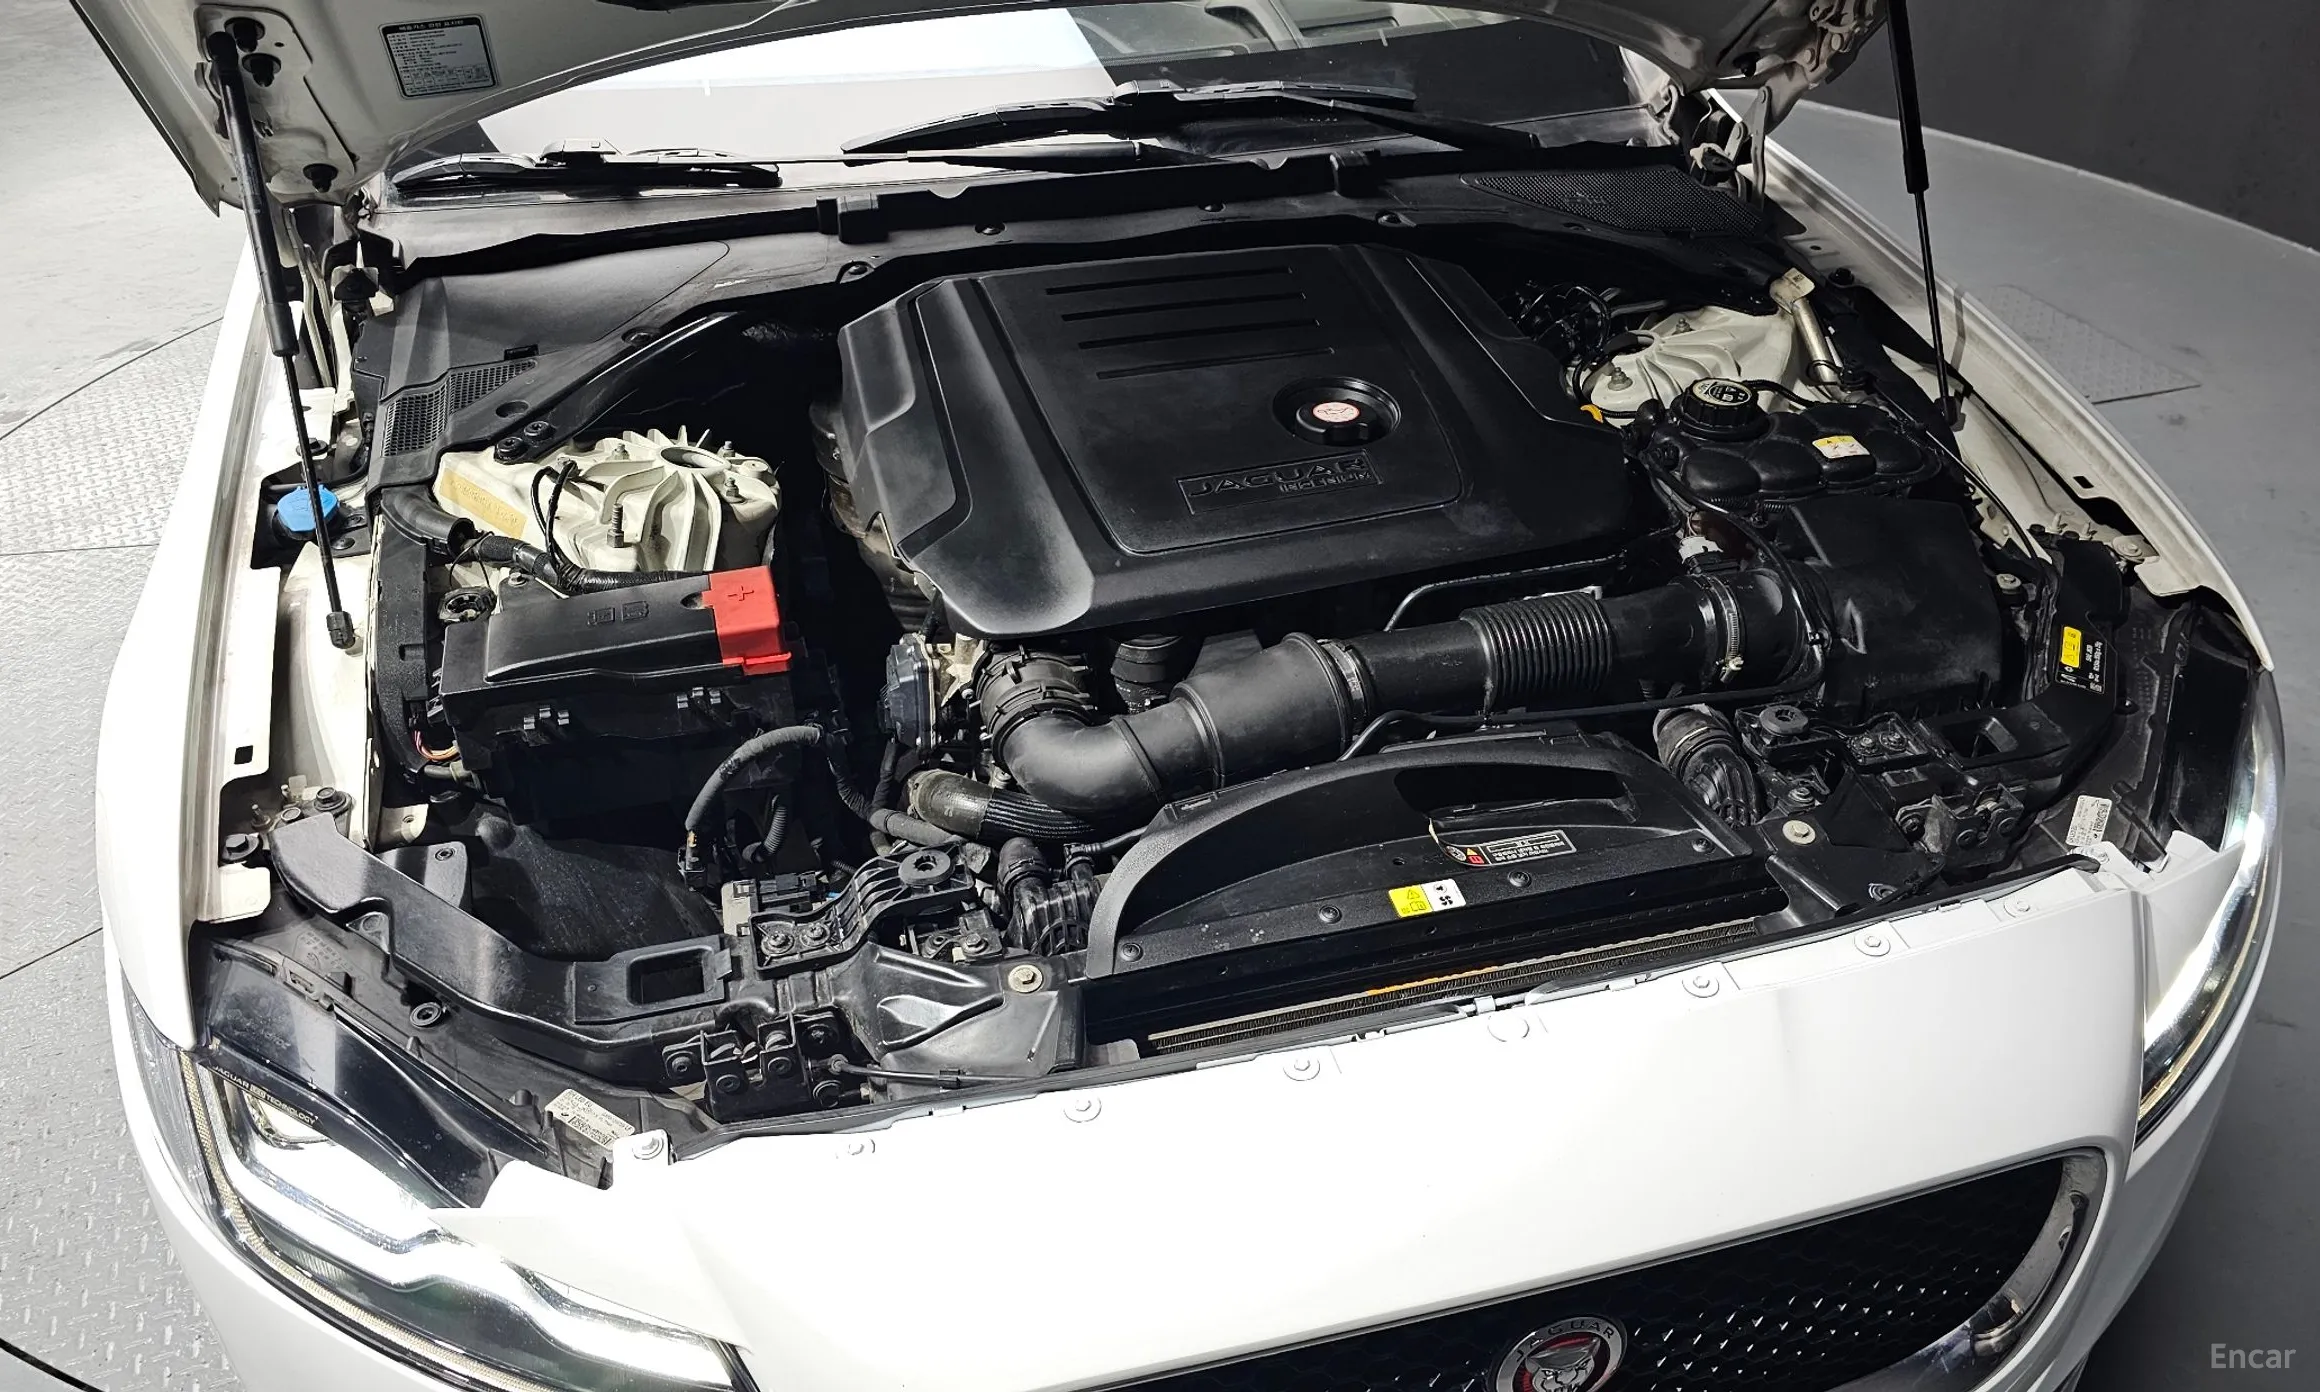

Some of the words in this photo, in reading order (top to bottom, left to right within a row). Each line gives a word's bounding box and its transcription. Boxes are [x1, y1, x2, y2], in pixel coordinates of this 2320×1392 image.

[1188, 458, 1366, 498] JAGUAR
[212, 1065, 249, 1089] JAGUAR
[266, 1096, 316, 1125] TECHNOLOGY
[1516, 1320, 1615, 1362] JAGUAR
